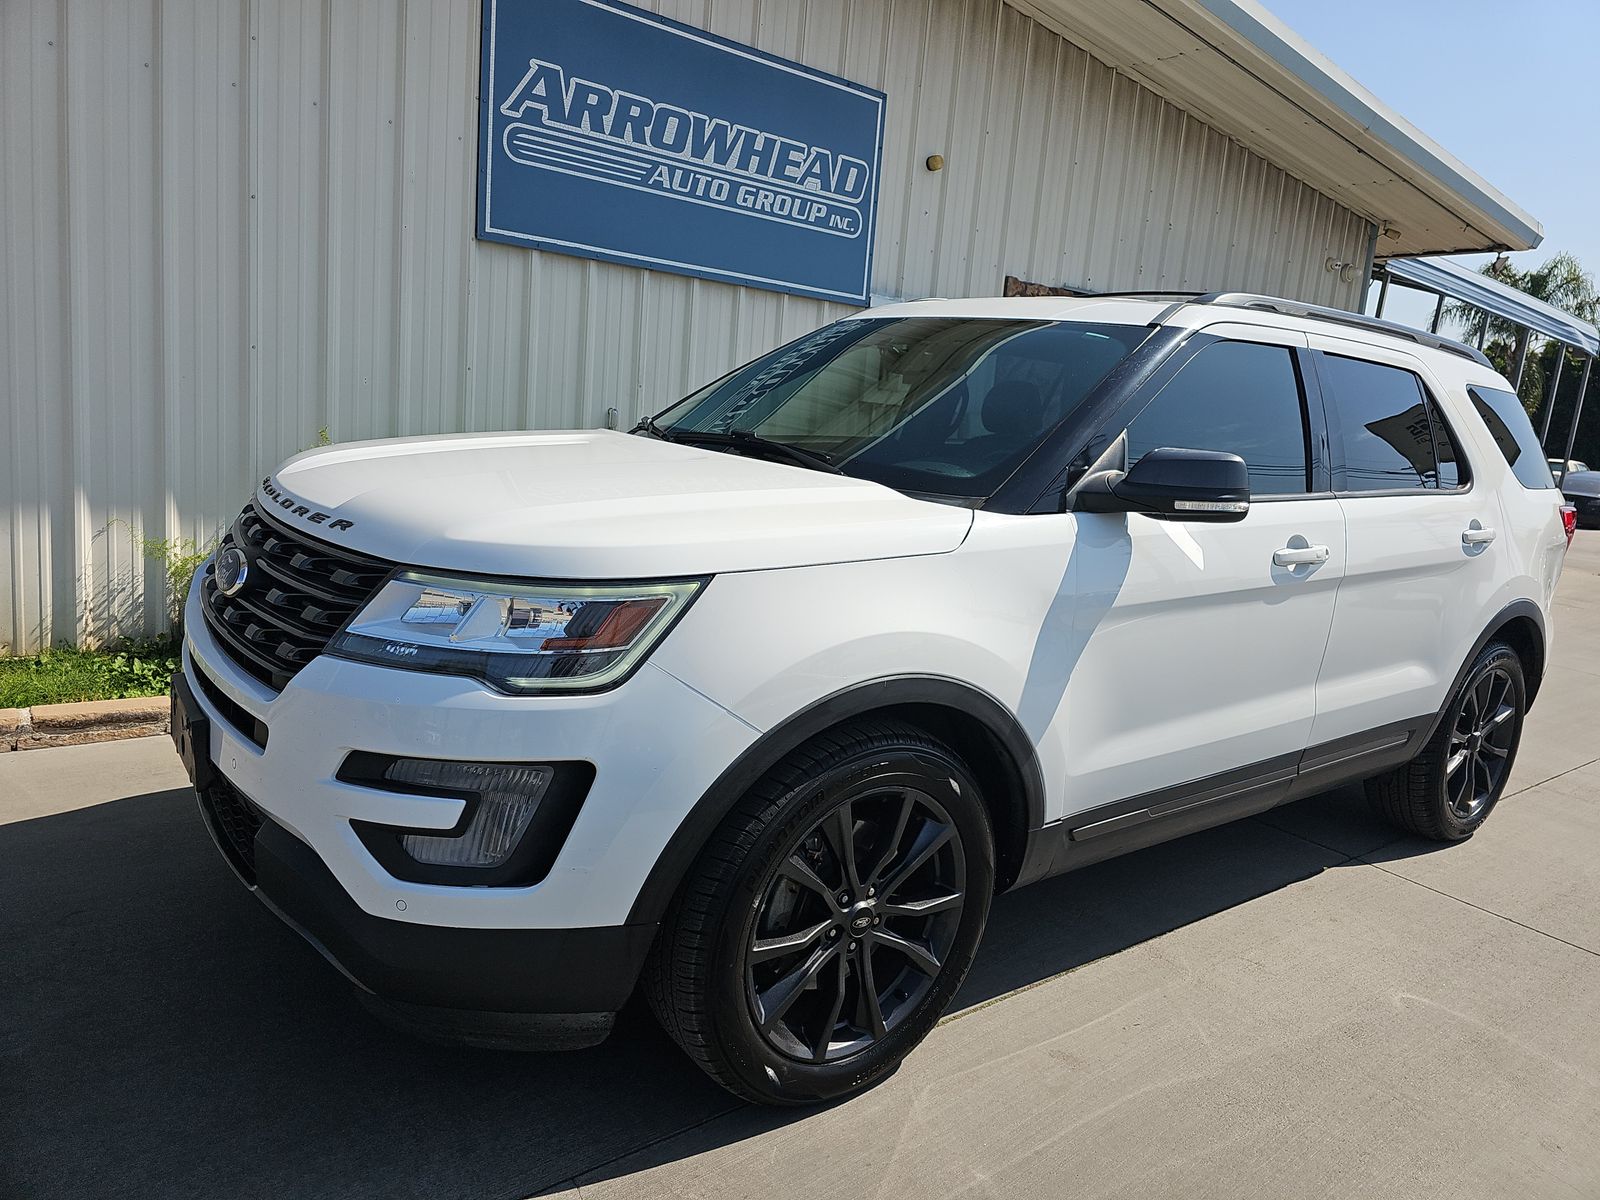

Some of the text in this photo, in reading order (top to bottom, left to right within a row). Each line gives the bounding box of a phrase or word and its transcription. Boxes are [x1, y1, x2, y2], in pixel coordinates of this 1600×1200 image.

[500, 58, 870, 202] ARROWHEAD
[648, 165, 855, 232] AUTO GROUP INC.
